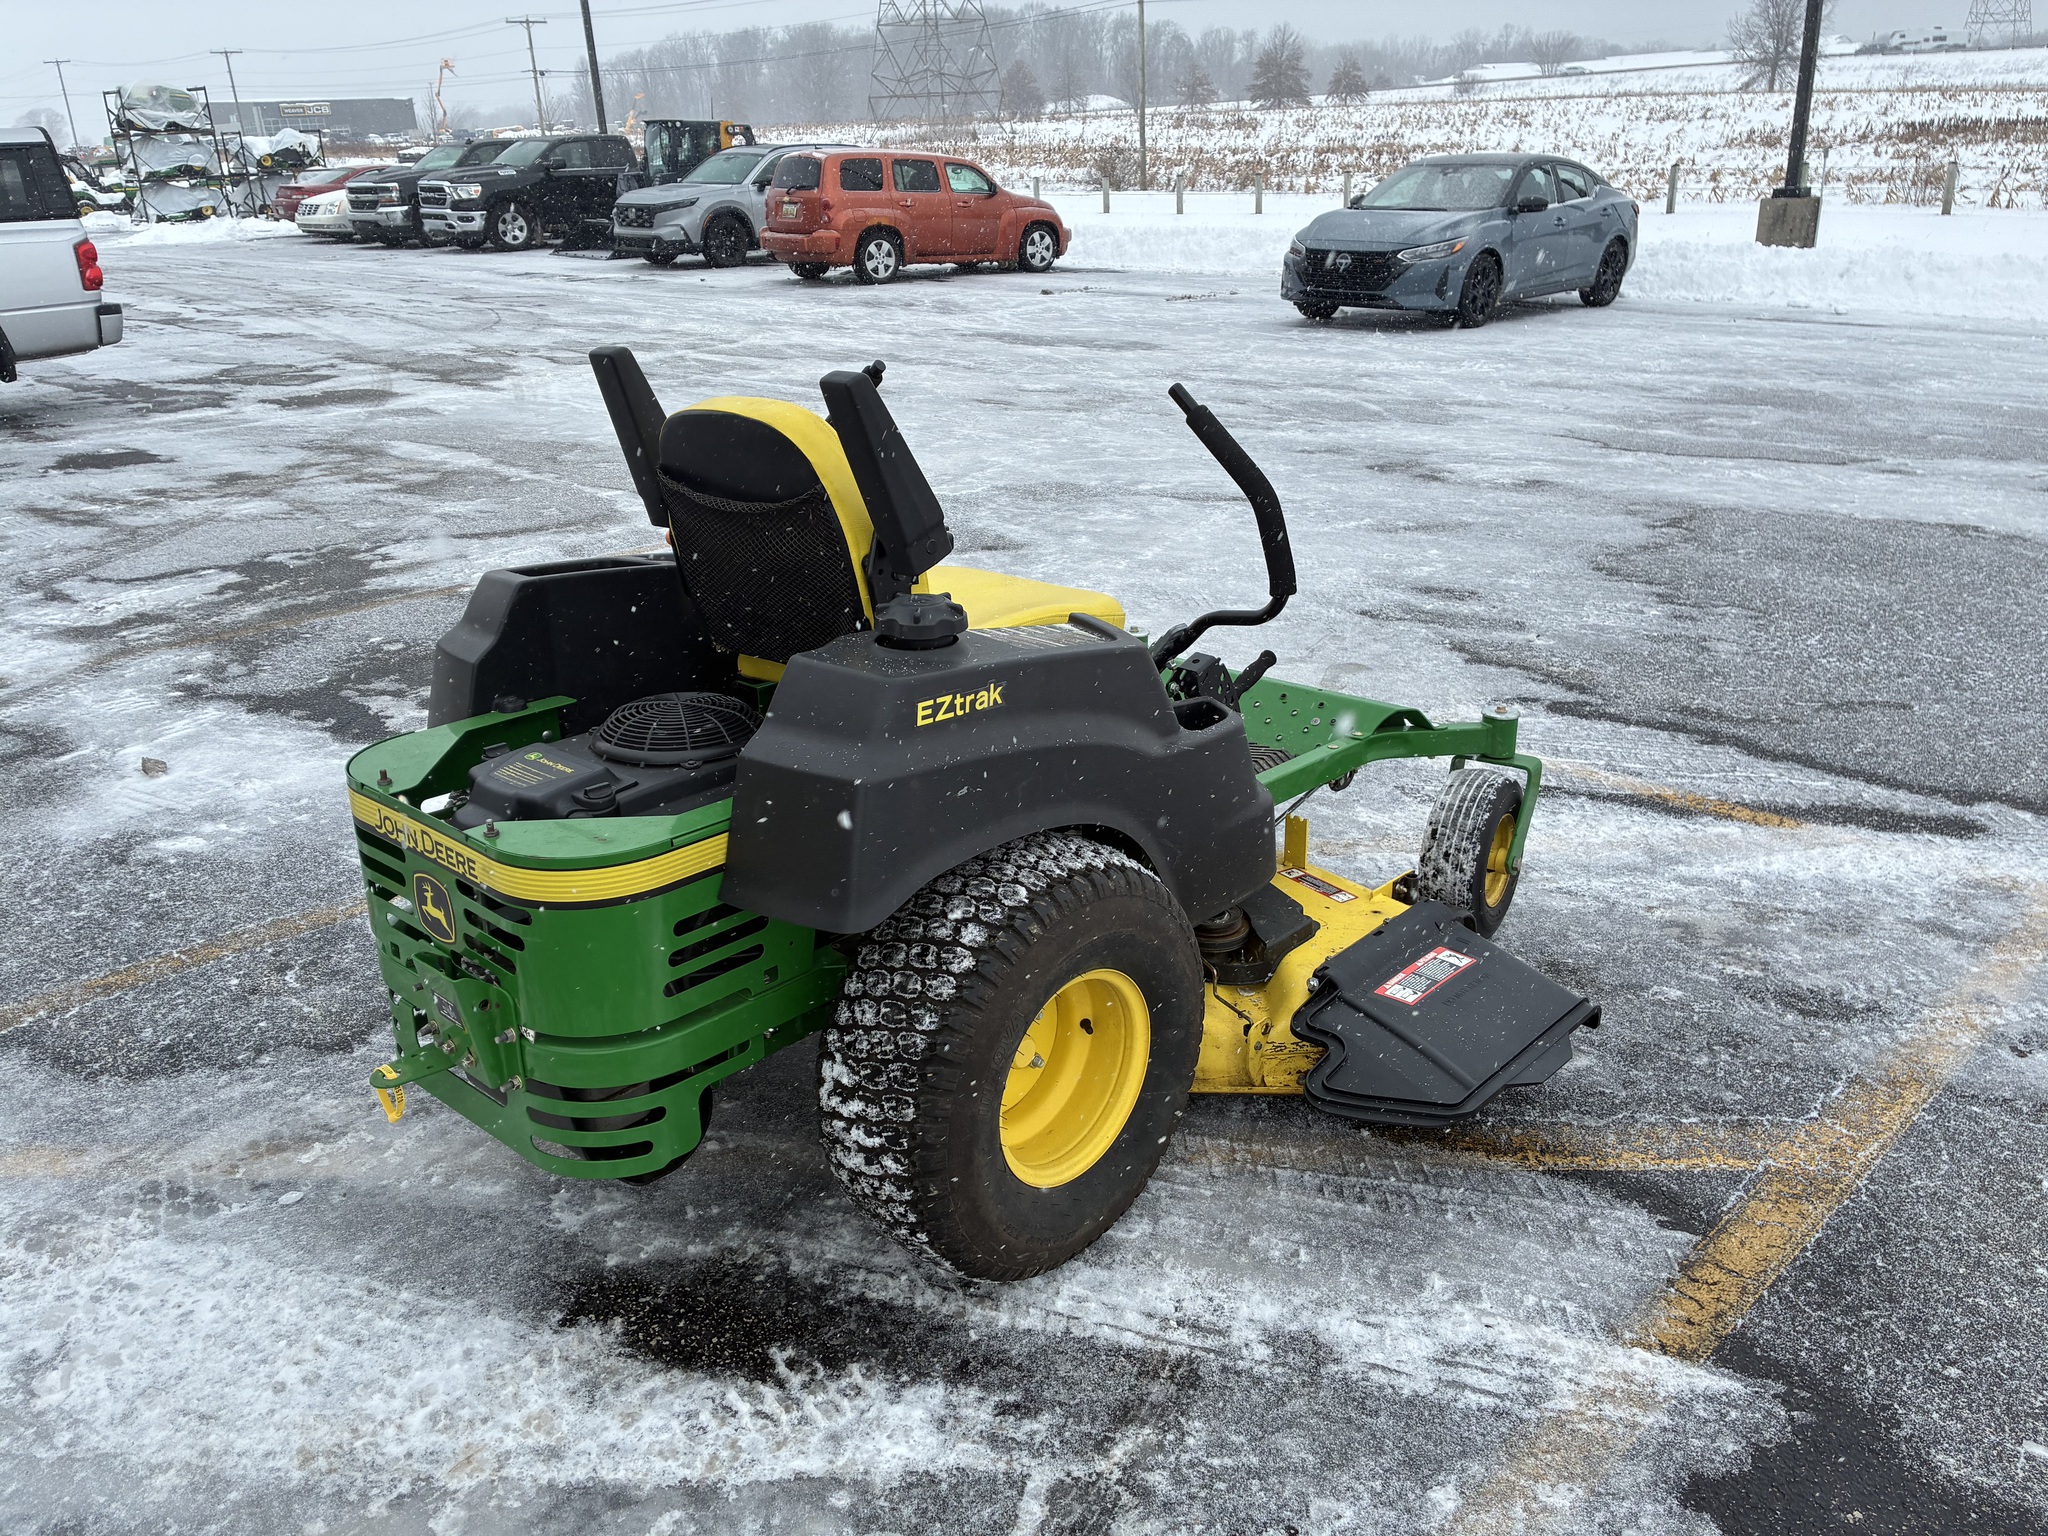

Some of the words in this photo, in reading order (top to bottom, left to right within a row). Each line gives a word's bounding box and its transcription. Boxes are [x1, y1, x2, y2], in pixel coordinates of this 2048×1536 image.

[307, 105, 330, 114] JCB
[916, 682, 1004, 727] EZtrak
[374, 808, 420, 850] JOHN
[421, 830, 480, 881] DEERE
